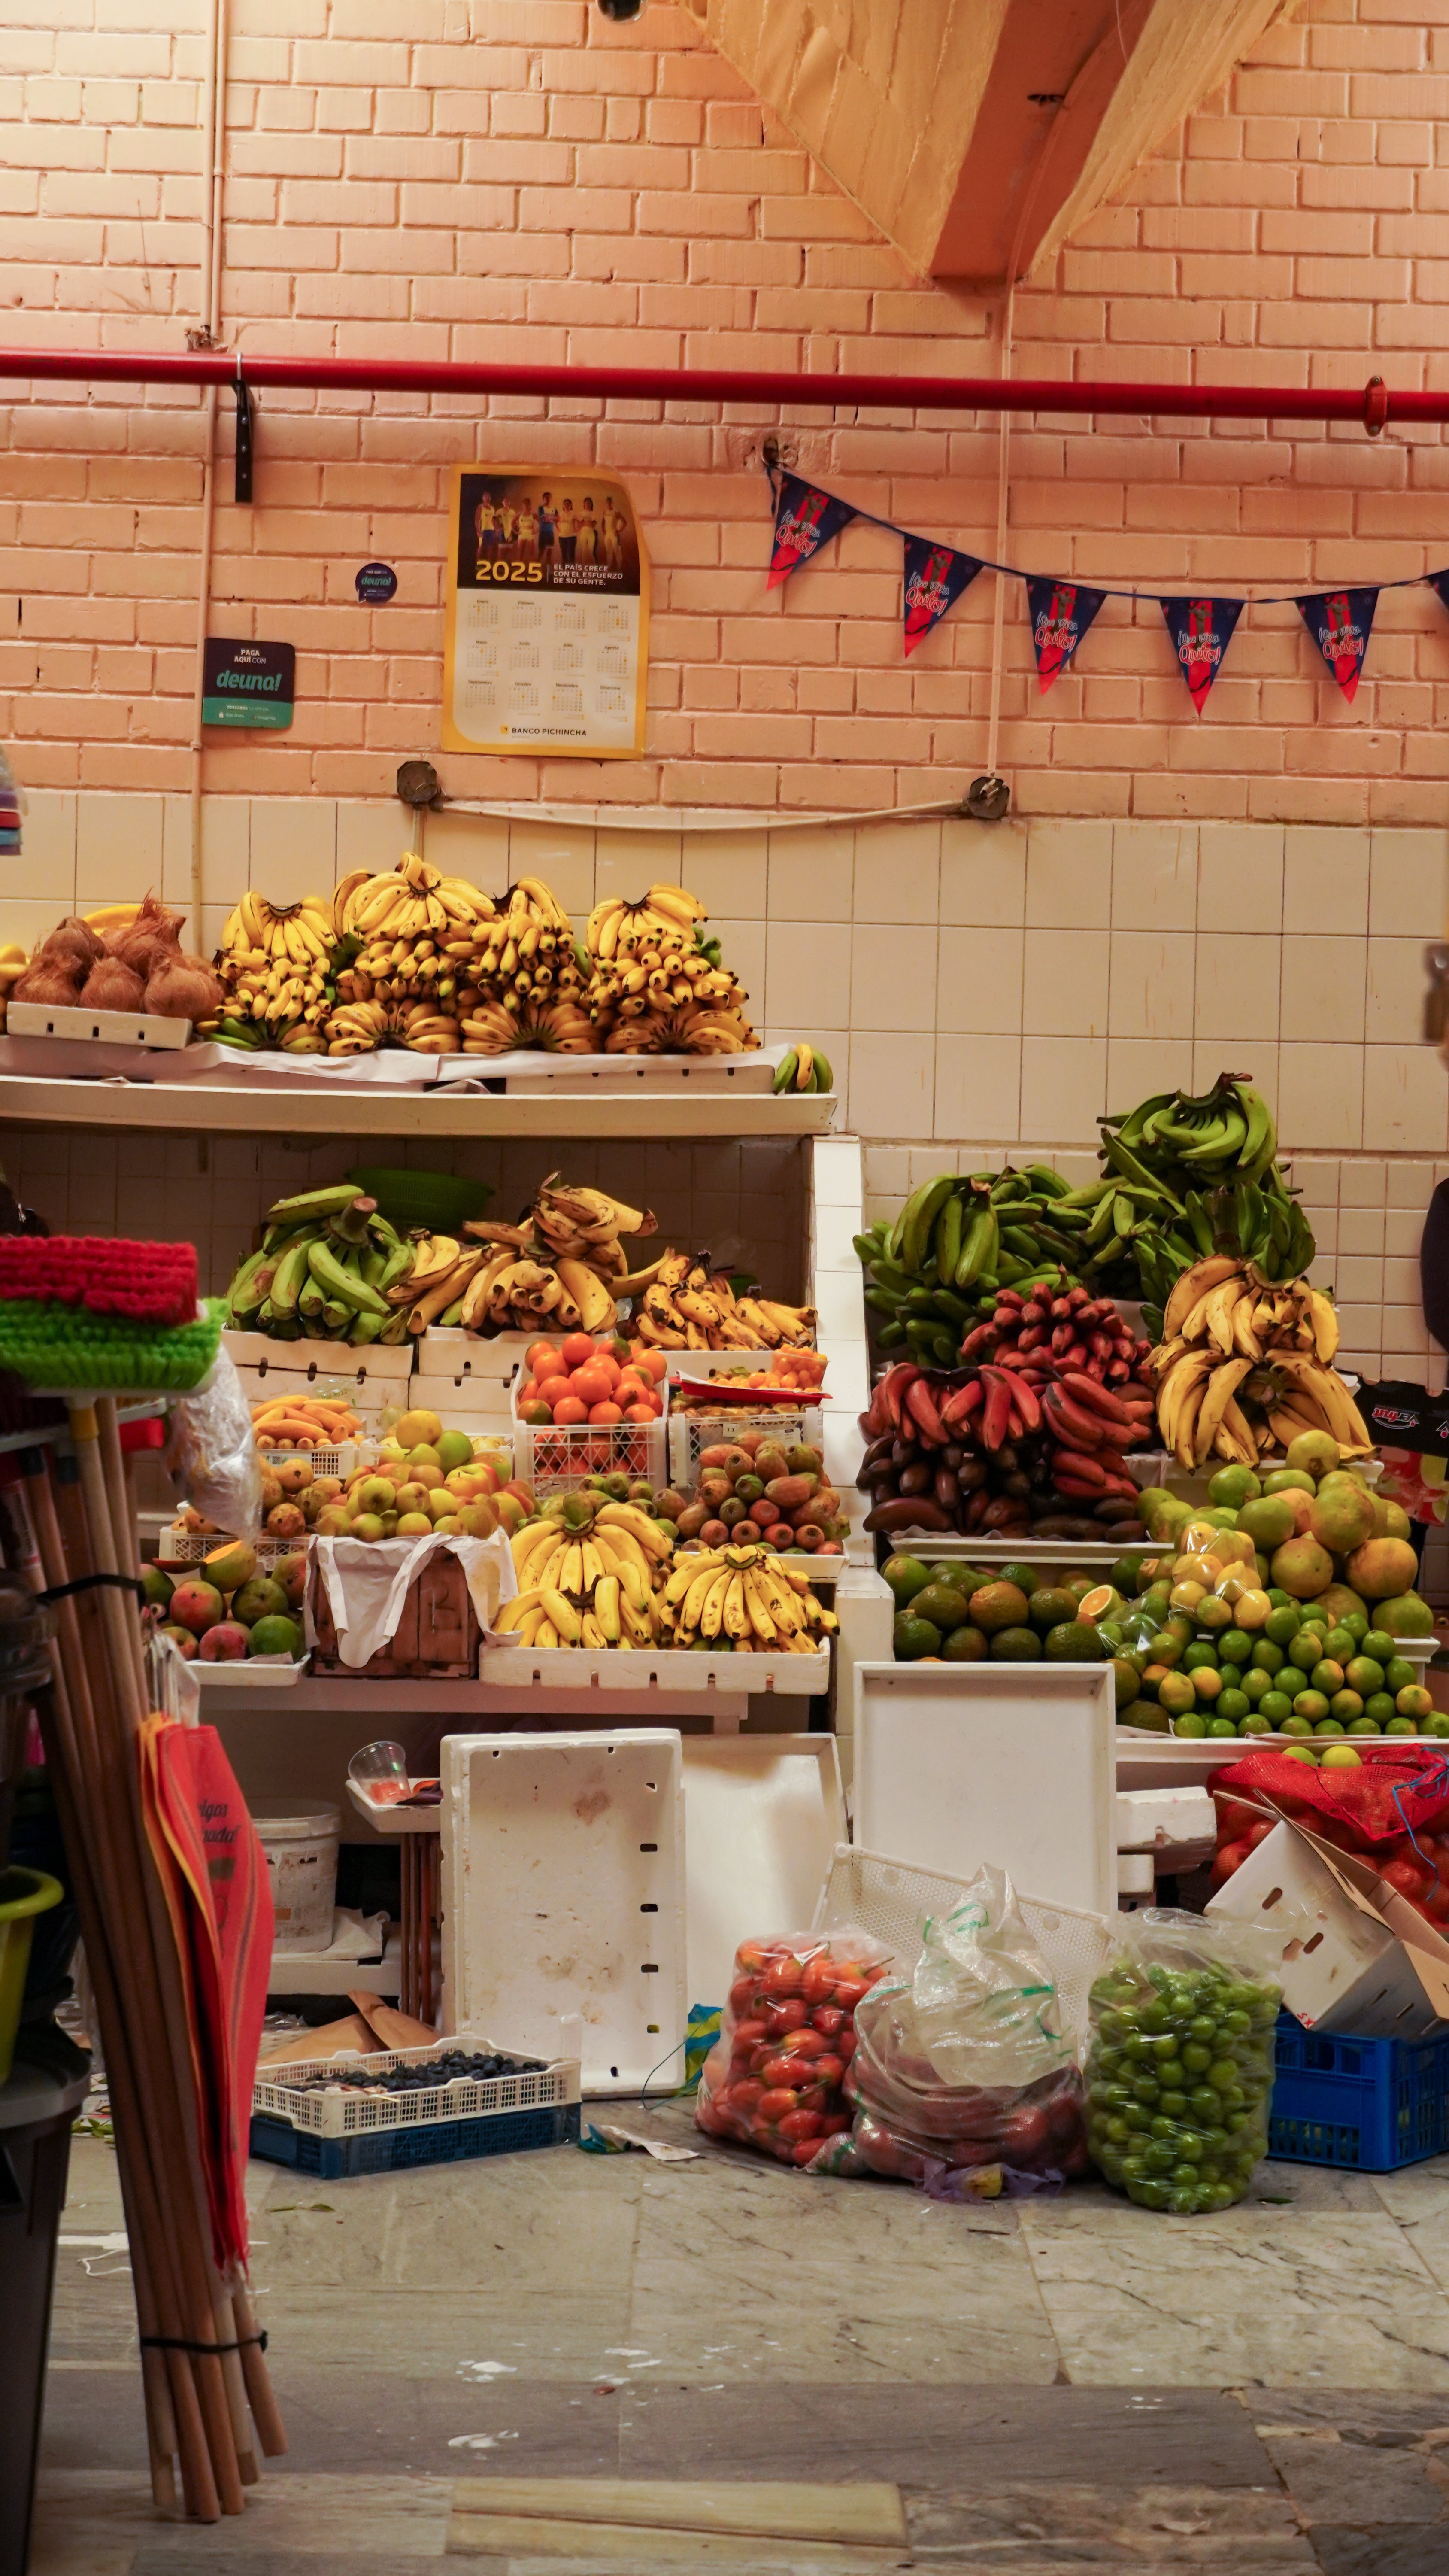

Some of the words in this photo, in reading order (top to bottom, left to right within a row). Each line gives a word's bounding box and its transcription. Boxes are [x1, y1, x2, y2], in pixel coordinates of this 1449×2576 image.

[801, 522, 820, 538] viva
[776, 525, 818, 558] Quito!
[476, 560, 543, 583] 2025
[565, 564, 582, 572] PAÍS
[930, 582, 949, 595] viva
[906, 586, 948, 617] Quito!
[1058, 618, 1078, 631] viva
[1339, 625, 1361, 636] viva
[1035, 626, 1078, 653] Quito!
[1199, 633, 1220, 644] viva
[1322, 635, 1364, 661] Quito!
[1179, 642, 1221, 665] Quito!
[216, 670, 282, 692] deuna!
